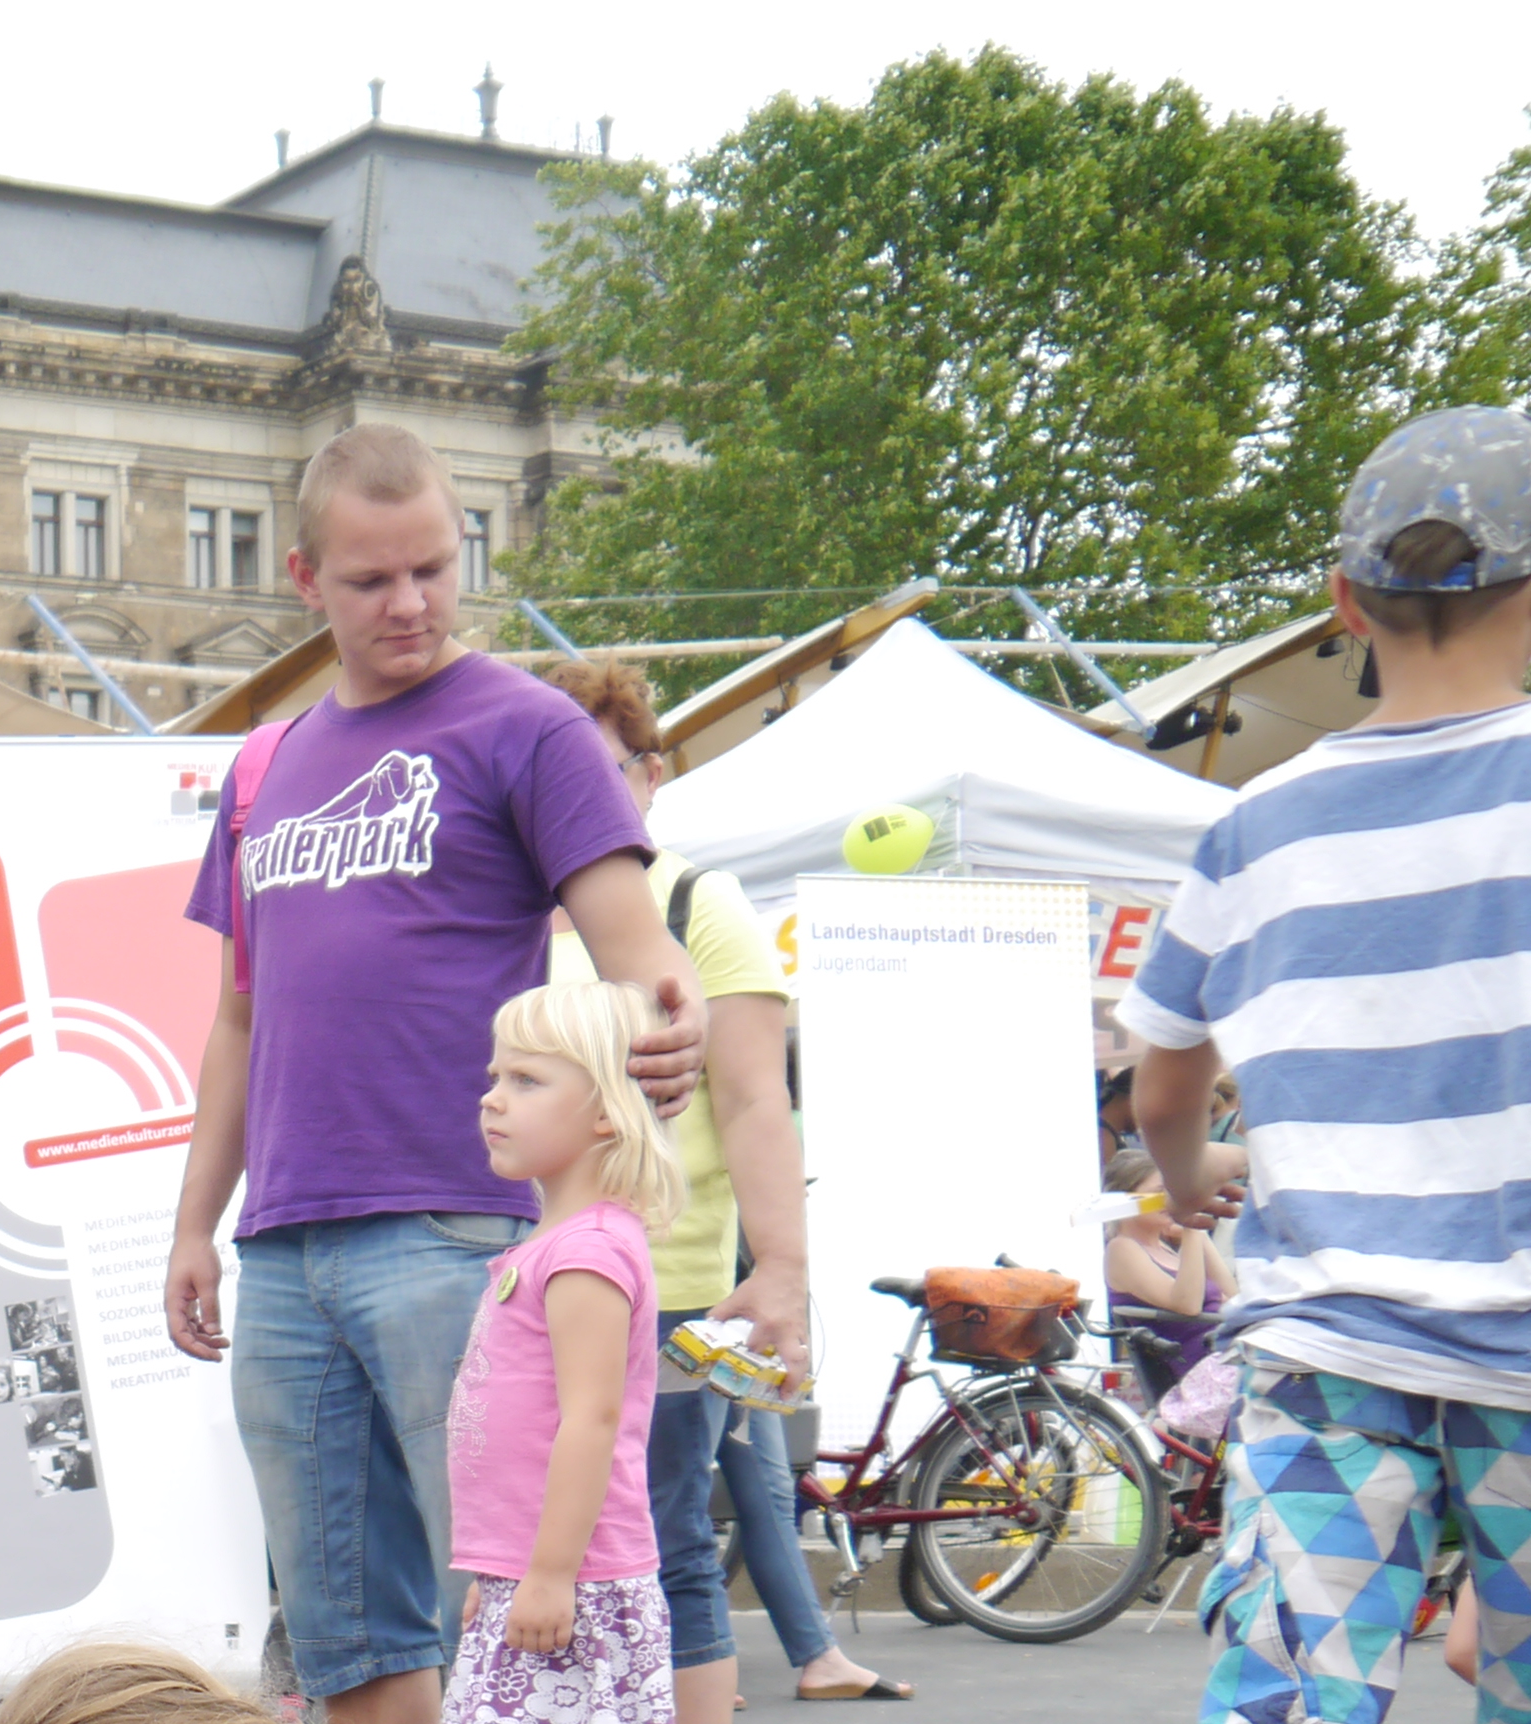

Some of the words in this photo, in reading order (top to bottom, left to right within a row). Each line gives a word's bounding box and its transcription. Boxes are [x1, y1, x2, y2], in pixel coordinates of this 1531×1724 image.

[811, 922, 977, 945] Landeshauptstadt
[983, 926, 1058, 945] Dresden
[812, 953, 908, 974] Jugendamt
[103, 1325, 163, 1345] BILDUNG
[110, 1364, 192, 1390] KREATIVITÄT
